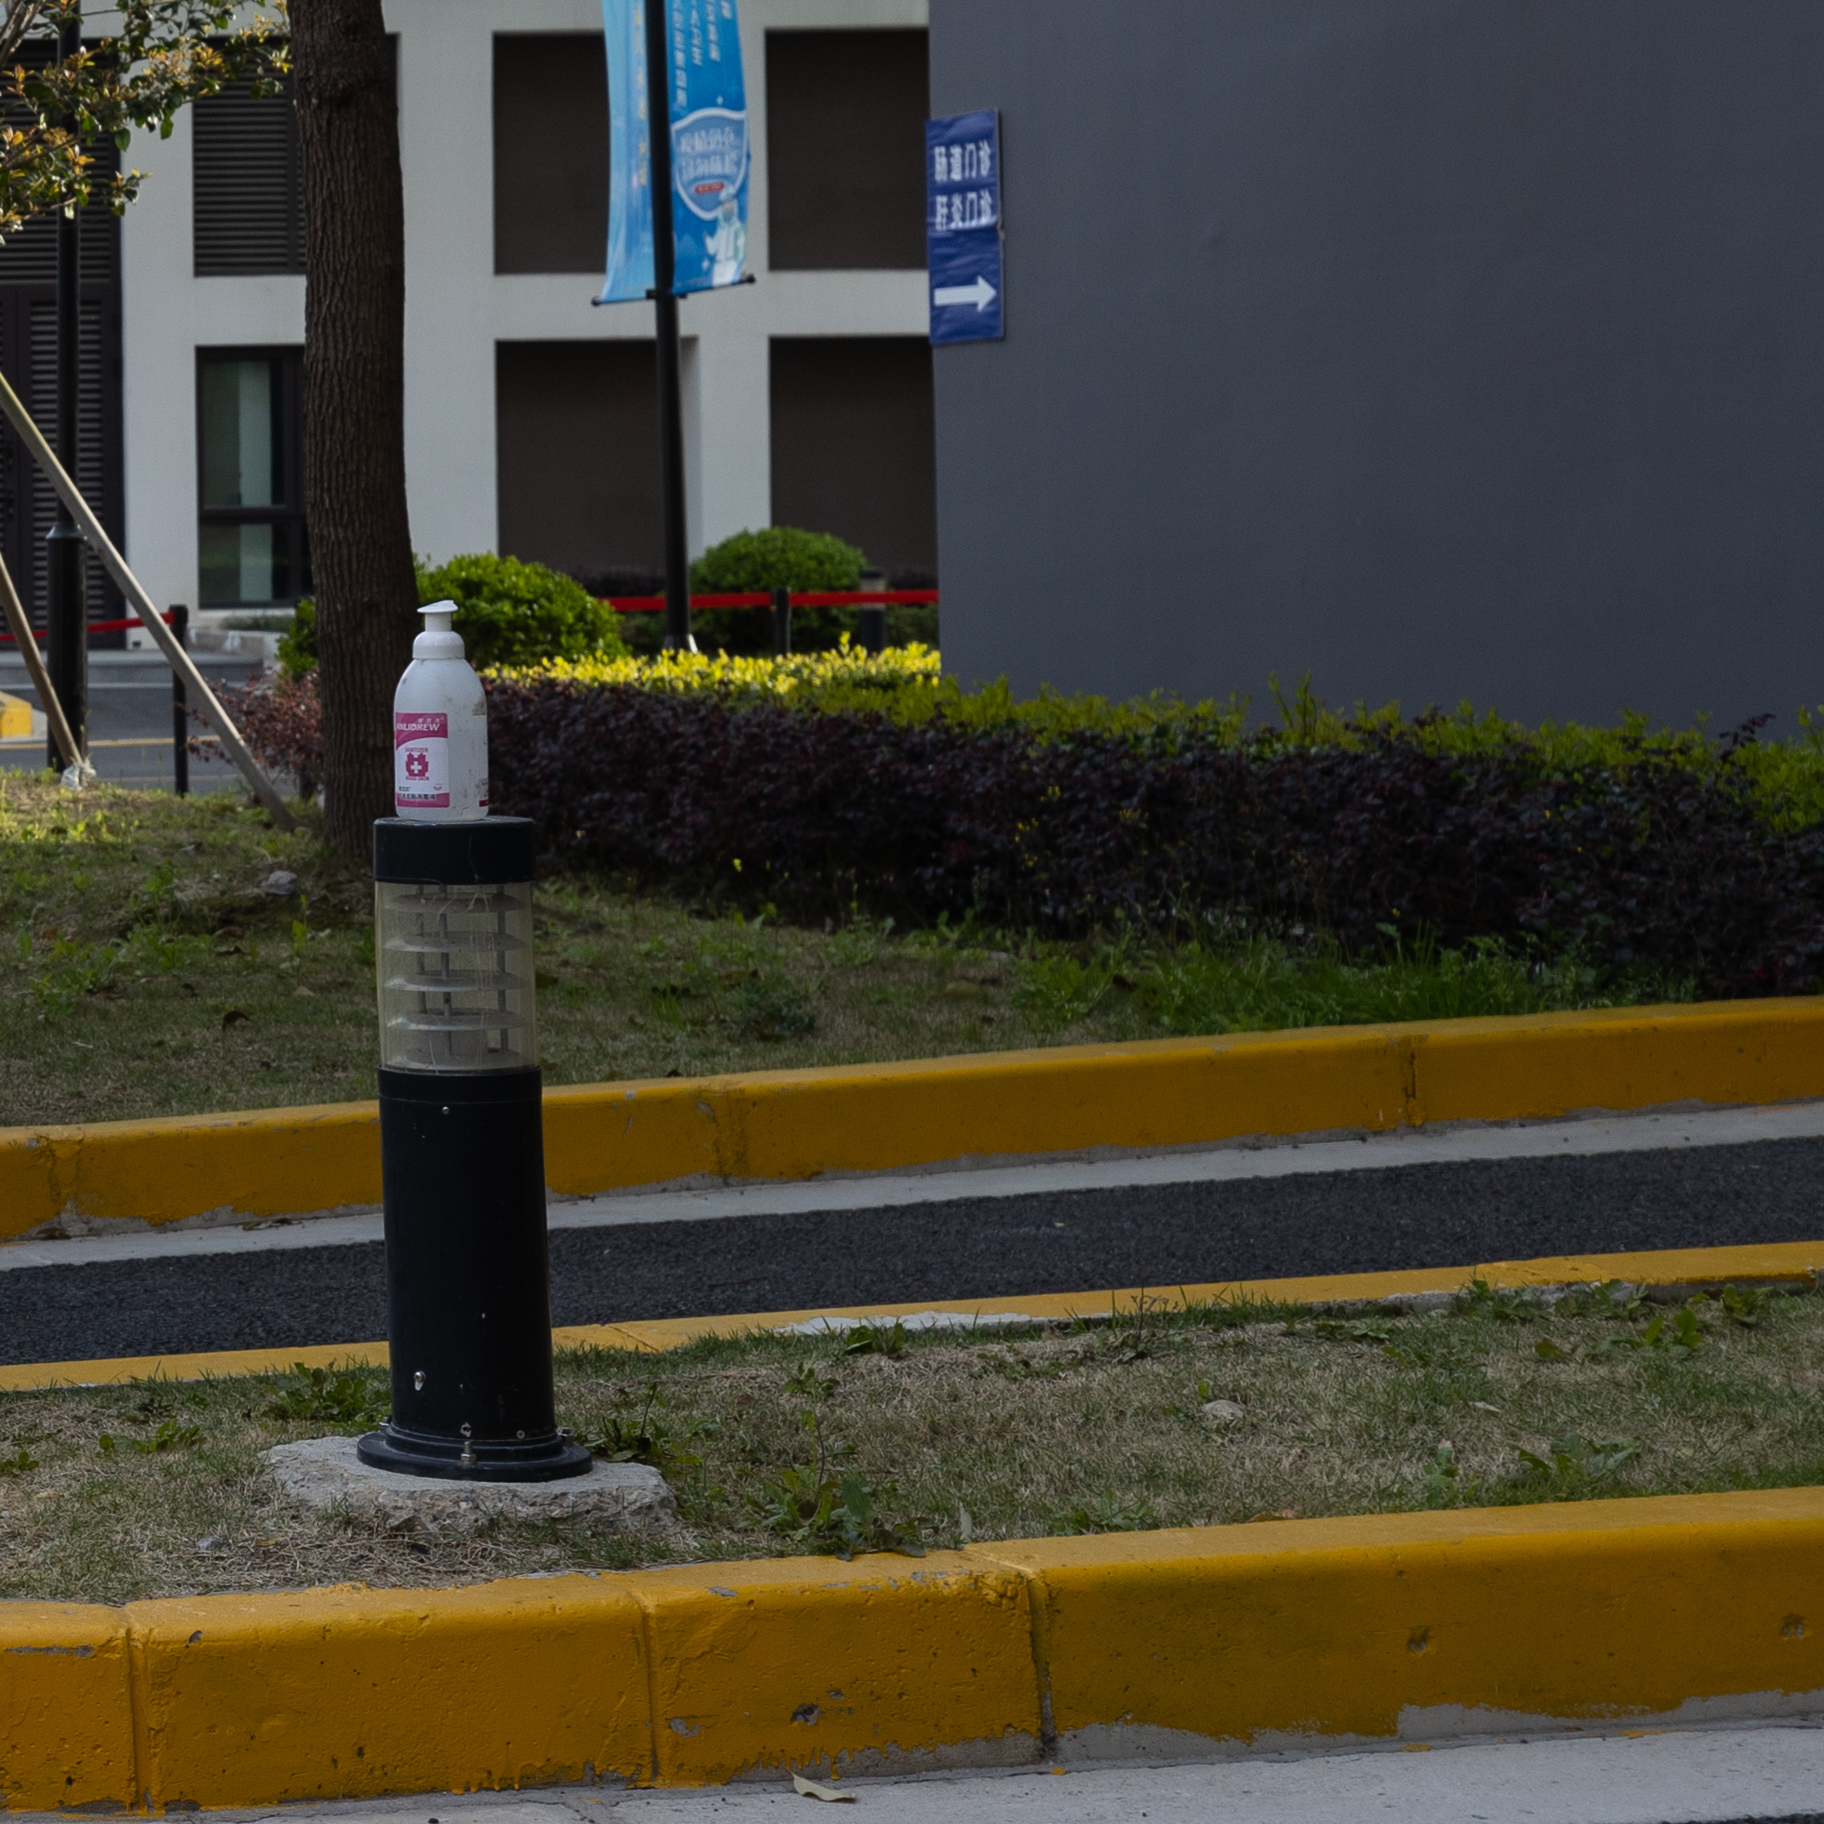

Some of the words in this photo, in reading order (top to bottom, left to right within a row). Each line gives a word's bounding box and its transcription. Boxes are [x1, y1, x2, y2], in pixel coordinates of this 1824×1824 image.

[934, 139, 992, 183] 肠道门诊
[935, 188, 994, 232] 肝炎门诊
